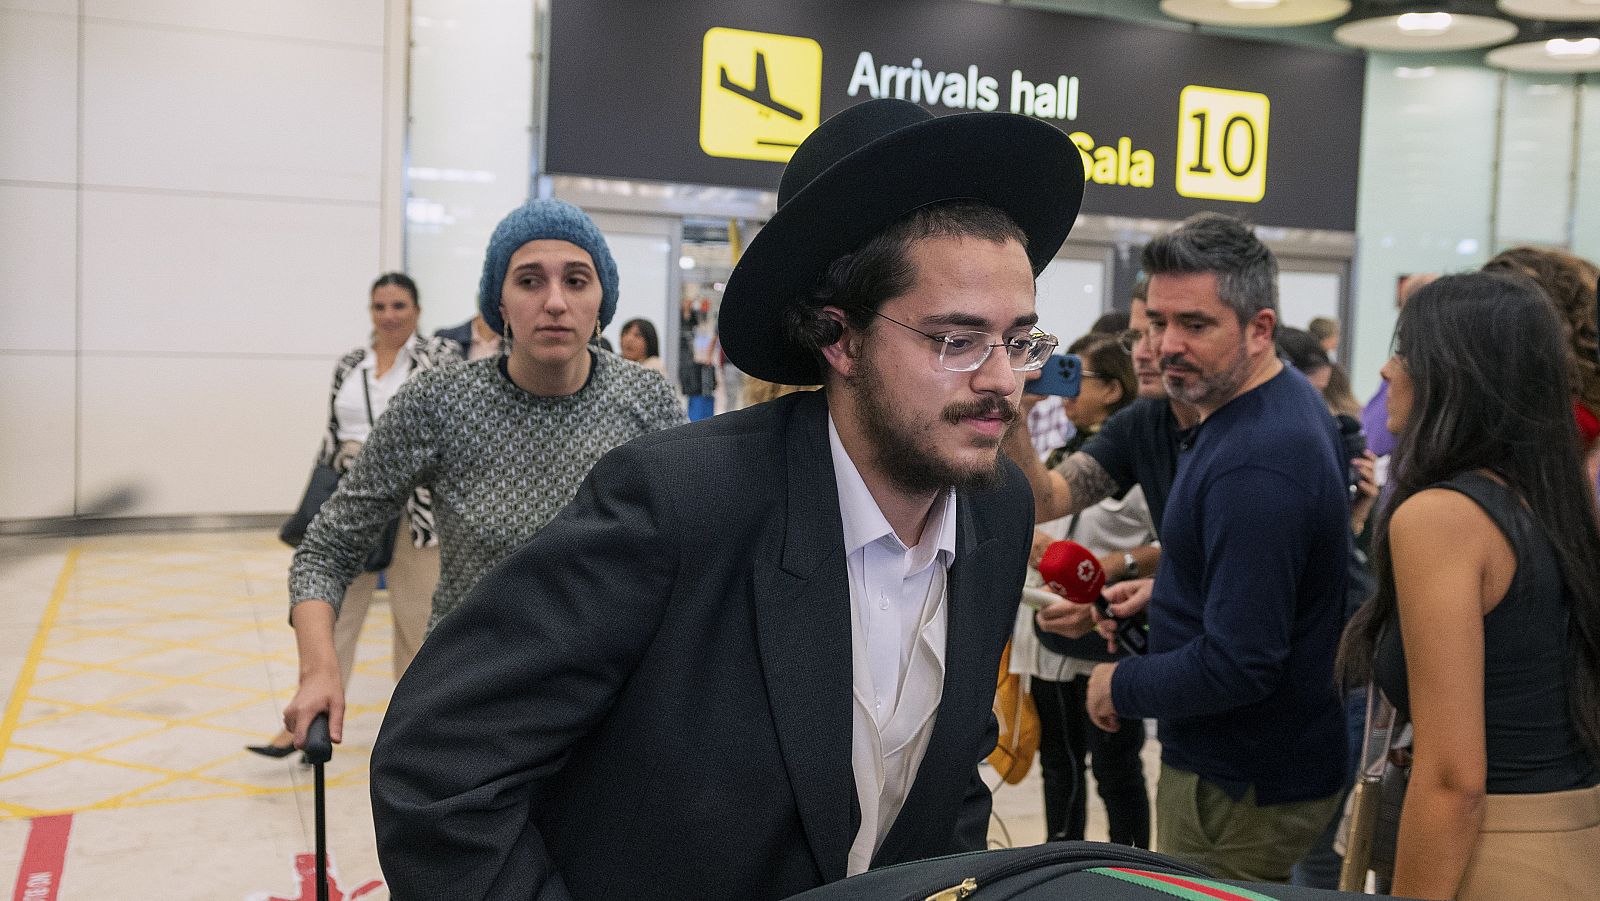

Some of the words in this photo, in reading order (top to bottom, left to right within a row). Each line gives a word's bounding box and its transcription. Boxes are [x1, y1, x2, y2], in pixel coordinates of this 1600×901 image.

[847, 51, 999, 112] Arrivals
[1010, 69, 1079, 120] hall
[1189, 113, 1255, 177] 10
